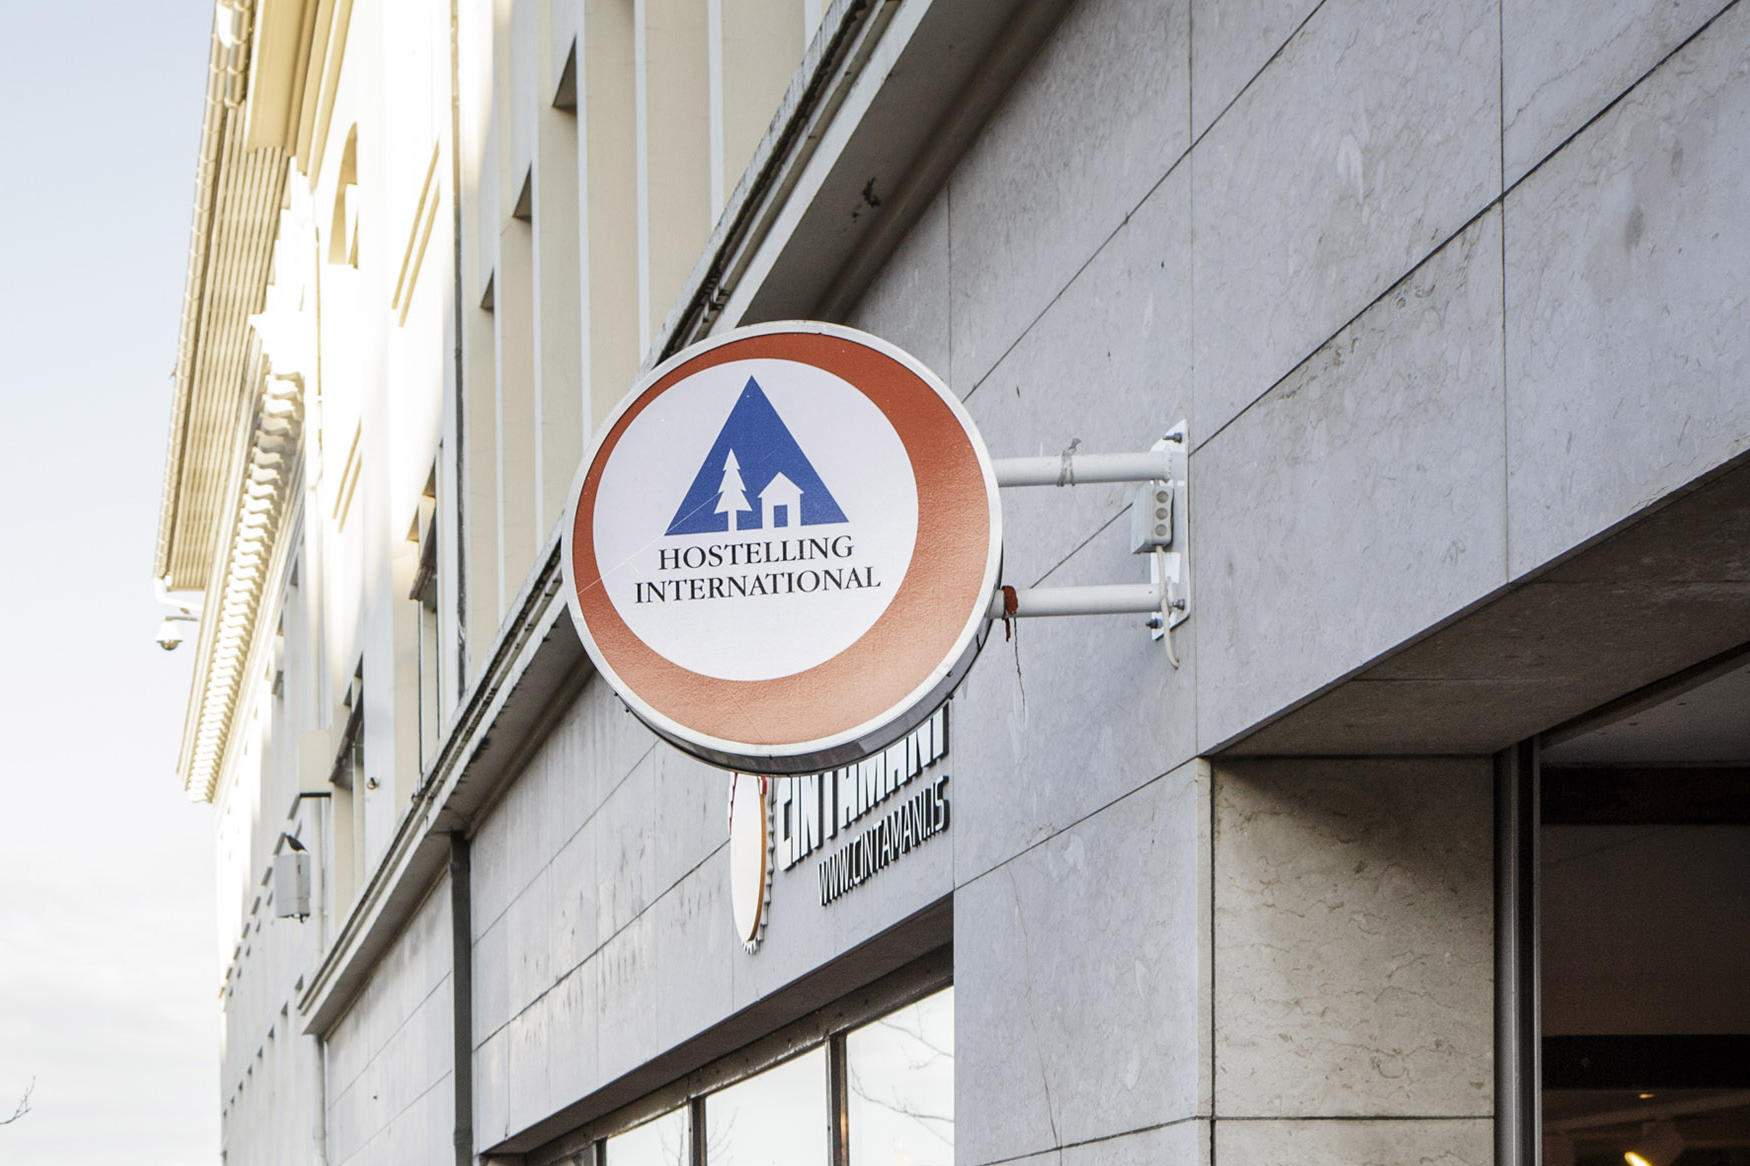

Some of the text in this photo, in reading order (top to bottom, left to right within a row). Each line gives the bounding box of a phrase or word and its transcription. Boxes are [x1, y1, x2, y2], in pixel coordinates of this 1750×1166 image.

[658, 535, 854, 570] HOSTELLING
[635, 566, 881, 604] INTERNATIONAL
[817, 776, 949, 906] WWW.CINTAMANI.IS
